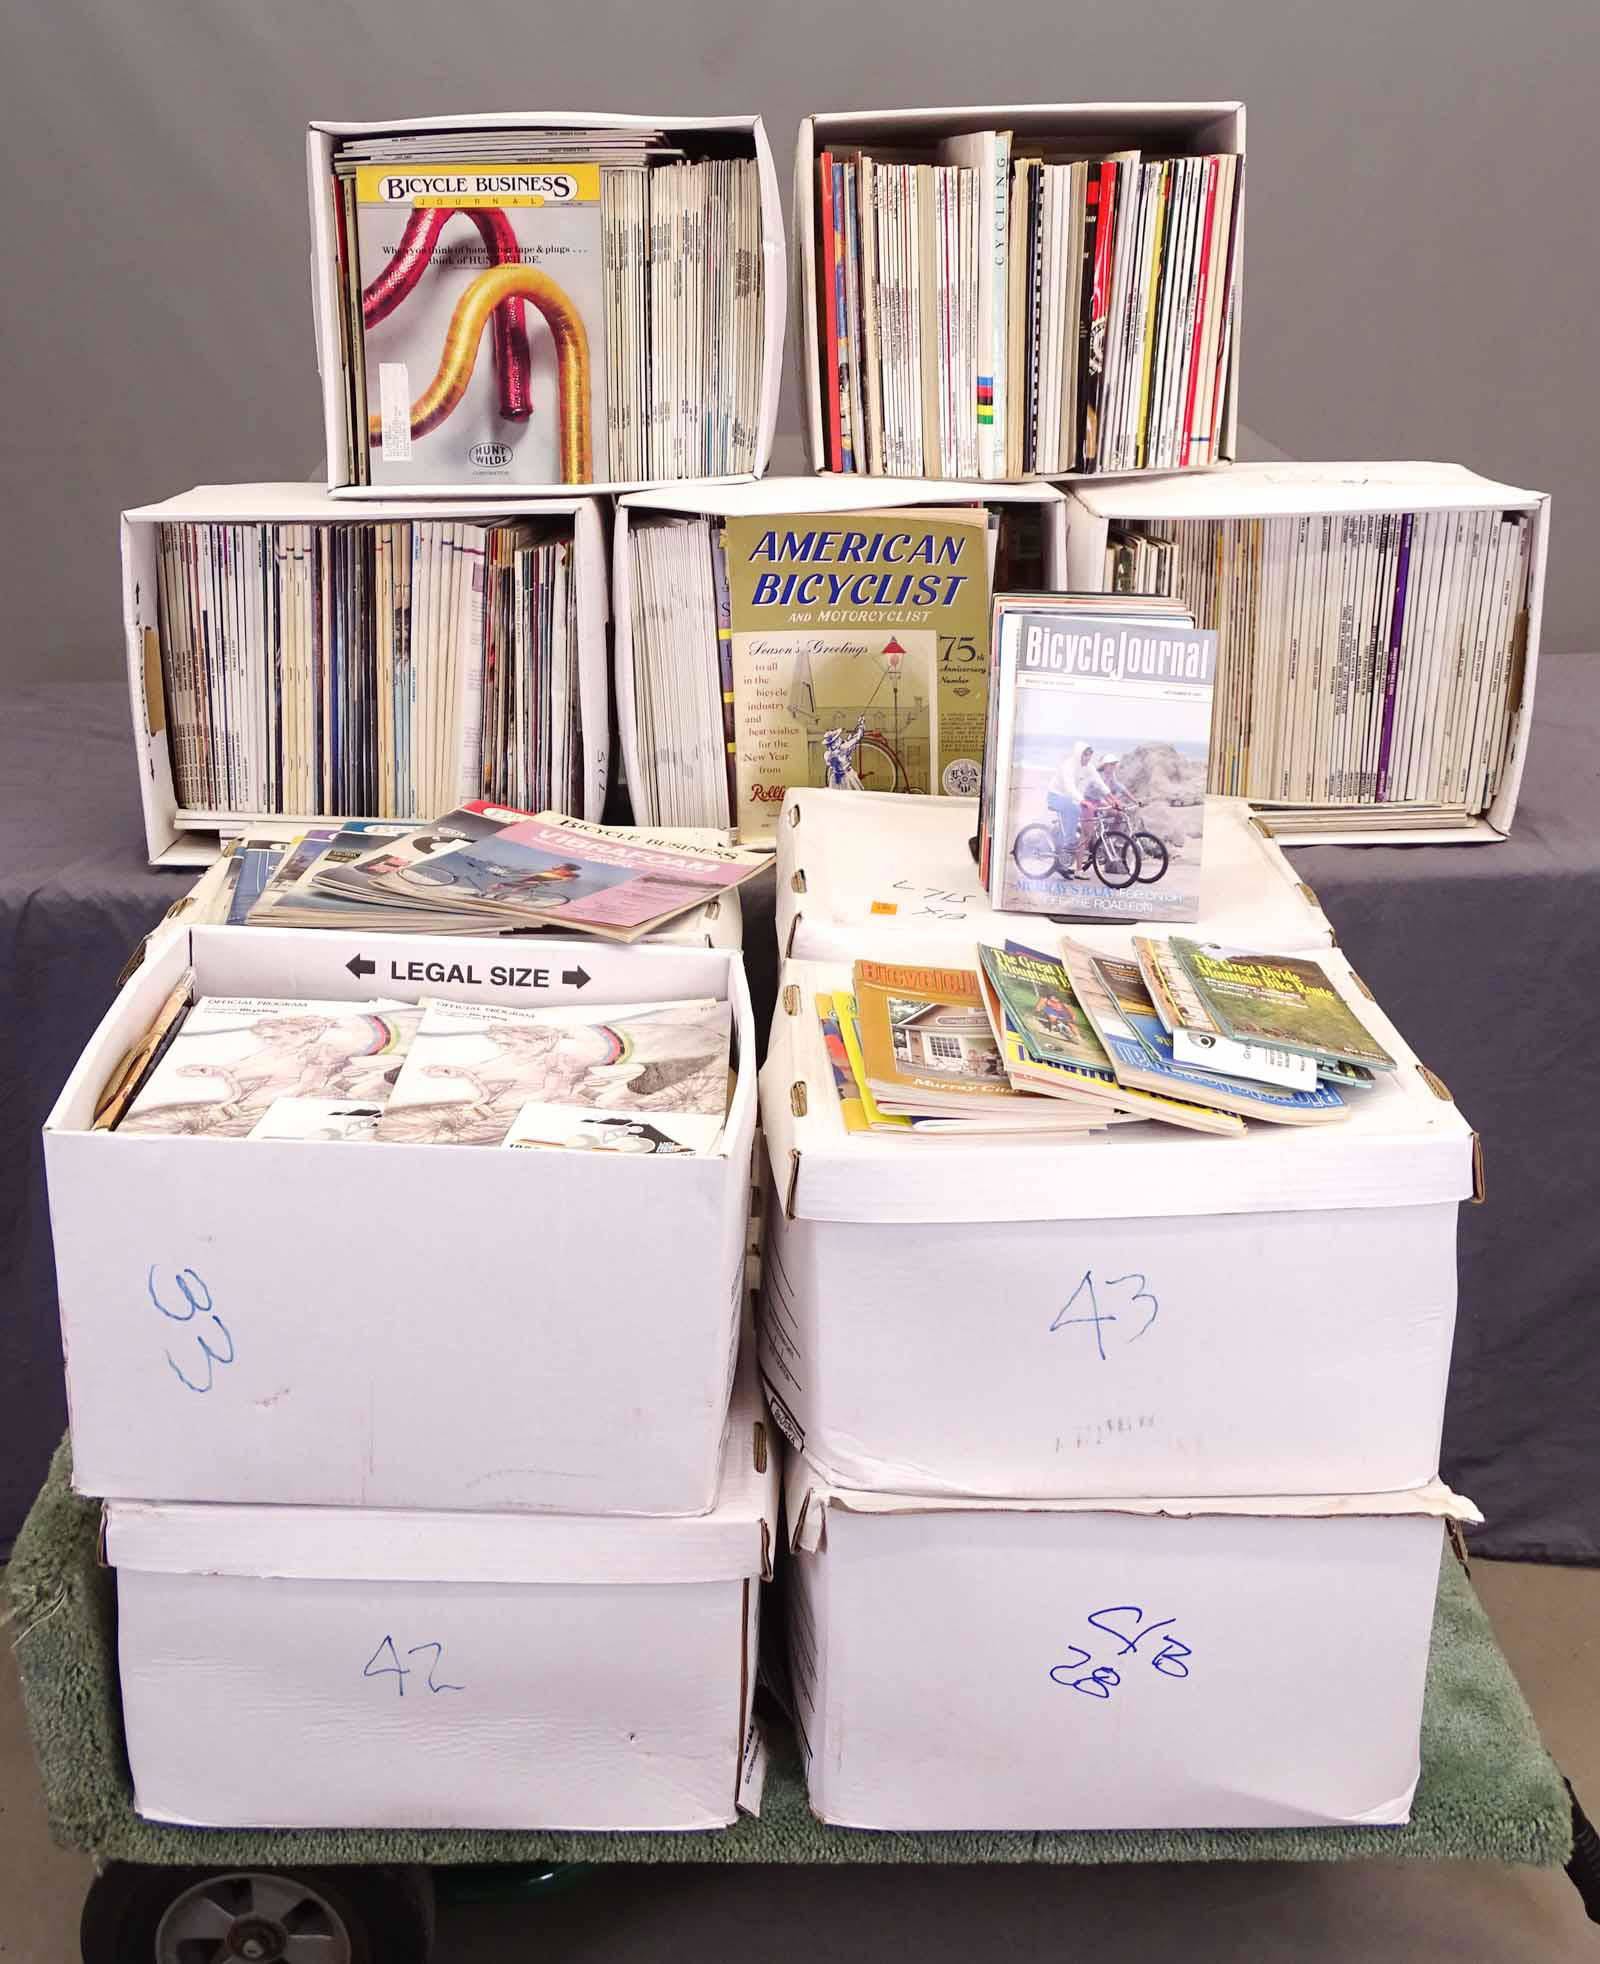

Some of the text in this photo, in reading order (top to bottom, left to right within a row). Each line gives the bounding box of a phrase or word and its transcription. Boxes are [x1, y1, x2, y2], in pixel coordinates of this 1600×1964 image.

[387, 176, 571, 200] BICYCLE BUSINESS
[420, 197, 538, 206] JOURNAL
[996, 155, 1007, 267] CYCLING
[545, 246, 571, 257] plugs
[475, 445, 506, 456] HUNT
[476, 455, 508, 465] WILDE
[749, 531, 967, 566] AMERICAN
[751, 573, 968, 607] BICYCLIST
[787, 610, 932, 623] AND MOTORCYCLIST
[748, 639, 869, 659] Season's Greetings
[755, 661, 778, 671] to all
[743, 676, 769, 685] in the
[756, 687, 787, 699] bicycle
[747, 702, 784, 713] industry
[744, 715, 762, 723] and
[749, 727, 799, 736] best wishes
[758, 739, 789, 748] for the
[743, 752, 789, 762] New Year
[759, 766, 781, 774] from
[558, 819, 739, 860] BICYCLE BUSINESS
[991, 948, 1056, 973] The Great
[1189, 953, 1303, 982] The Great Divide
[391, 960, 550, 989] LEGAL SIZE
[998, 961, 1060, 985] Mountain
[1199, 966, 1262, 986] Mountain
[1262, 977, 1295, 992] Bike
[1295, 982, 1336, 1000] Route
[436, 1001, 535, 1019] OFFICIAL PROGRAM
[1050, 1270, 1159, 1361] 43
[363, 1635, 466, 1697] 42
